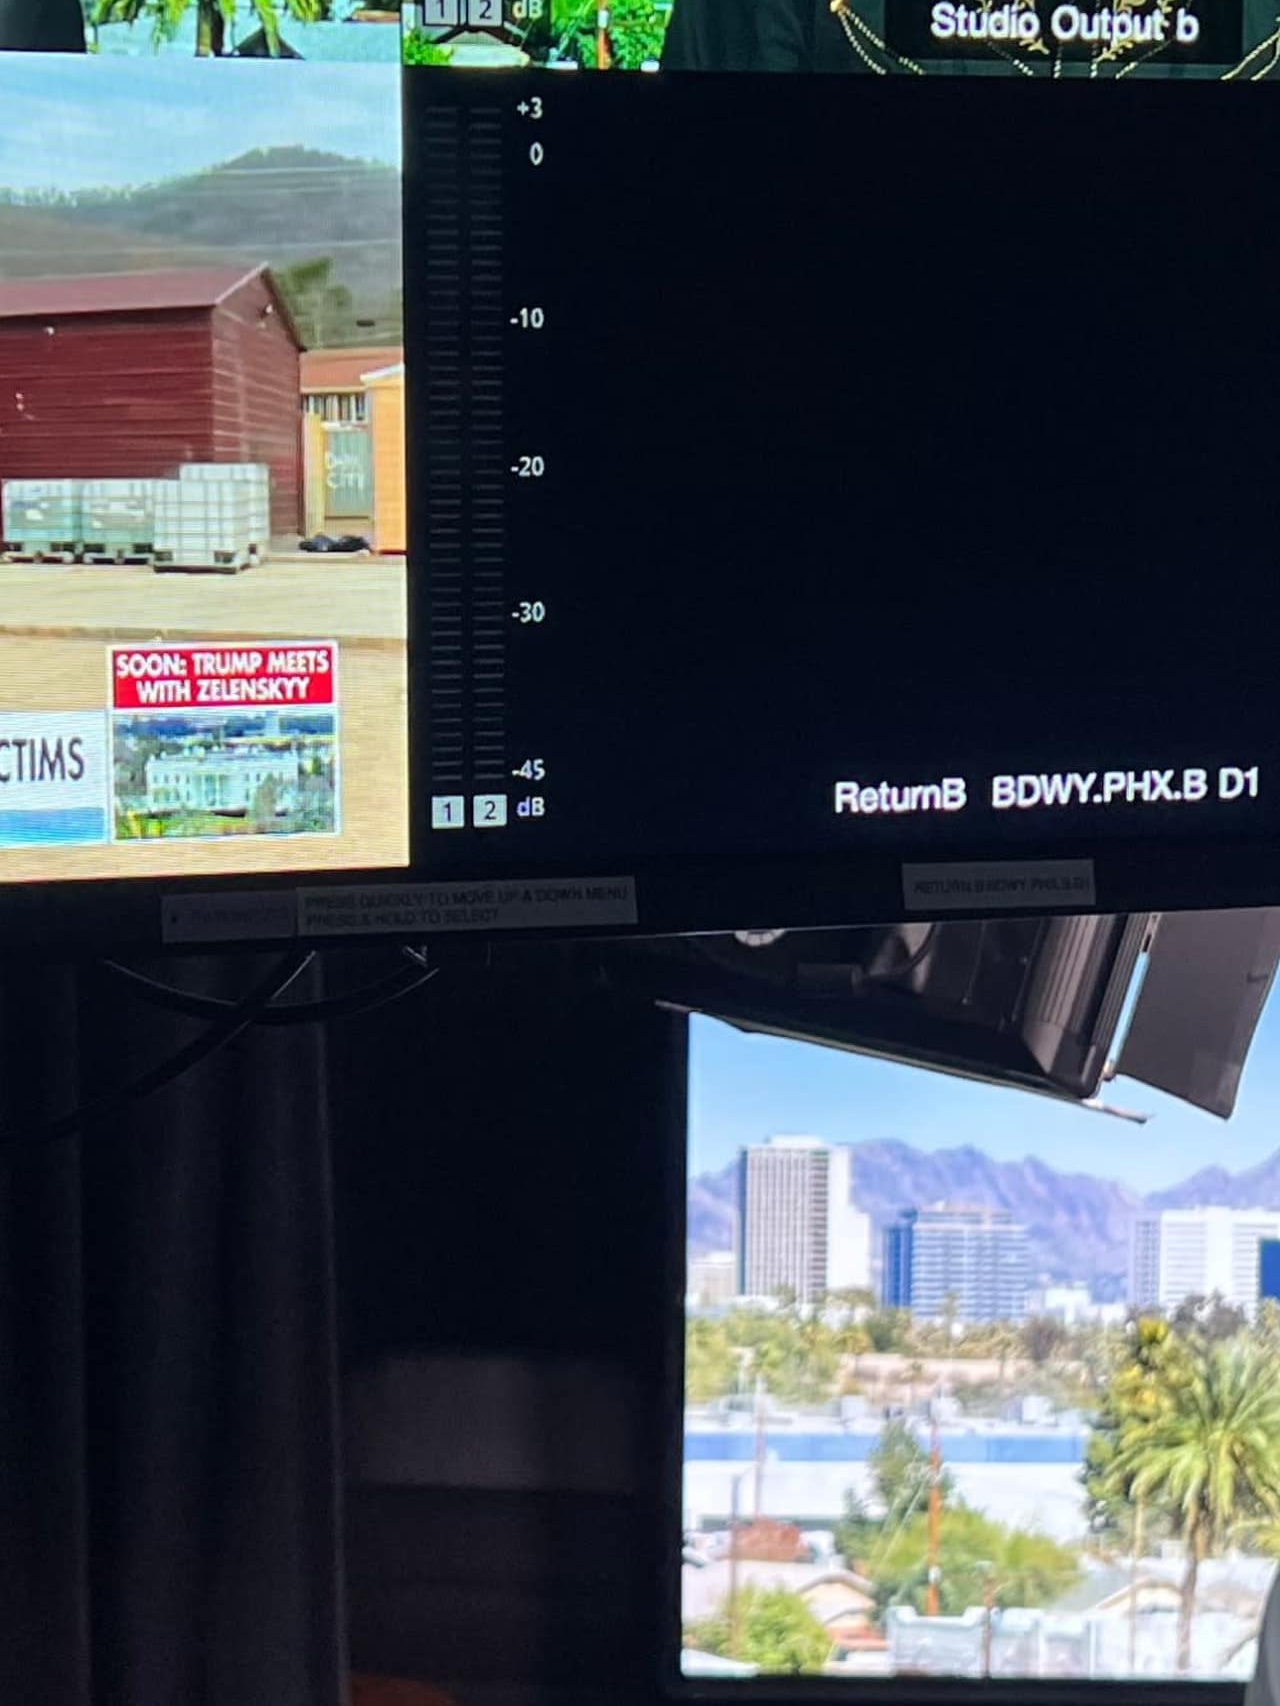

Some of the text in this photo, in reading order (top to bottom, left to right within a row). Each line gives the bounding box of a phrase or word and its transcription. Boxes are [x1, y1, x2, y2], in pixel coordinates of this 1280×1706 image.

[930, 0, 1200, 42] Studio Output b
[517, 97, 543, 119] +3
[530, 142, 544, 165] 0
[510, 307, 544, 329] -10
[510, 456, 544, 478] -20
[511, 601, 545, 623] -30
[116, 649, 329, 678] SOON: TRUMP MEETS
[136, 675, 310, 704] WITH ZELENSKYY
[511, 759, 546, 781] -45
[834, 766, 1260, 814] ReturnB BDWY.PHX.B D1
[483, 799, 498, 821] 2
[516, 796, 546, 818] dB
